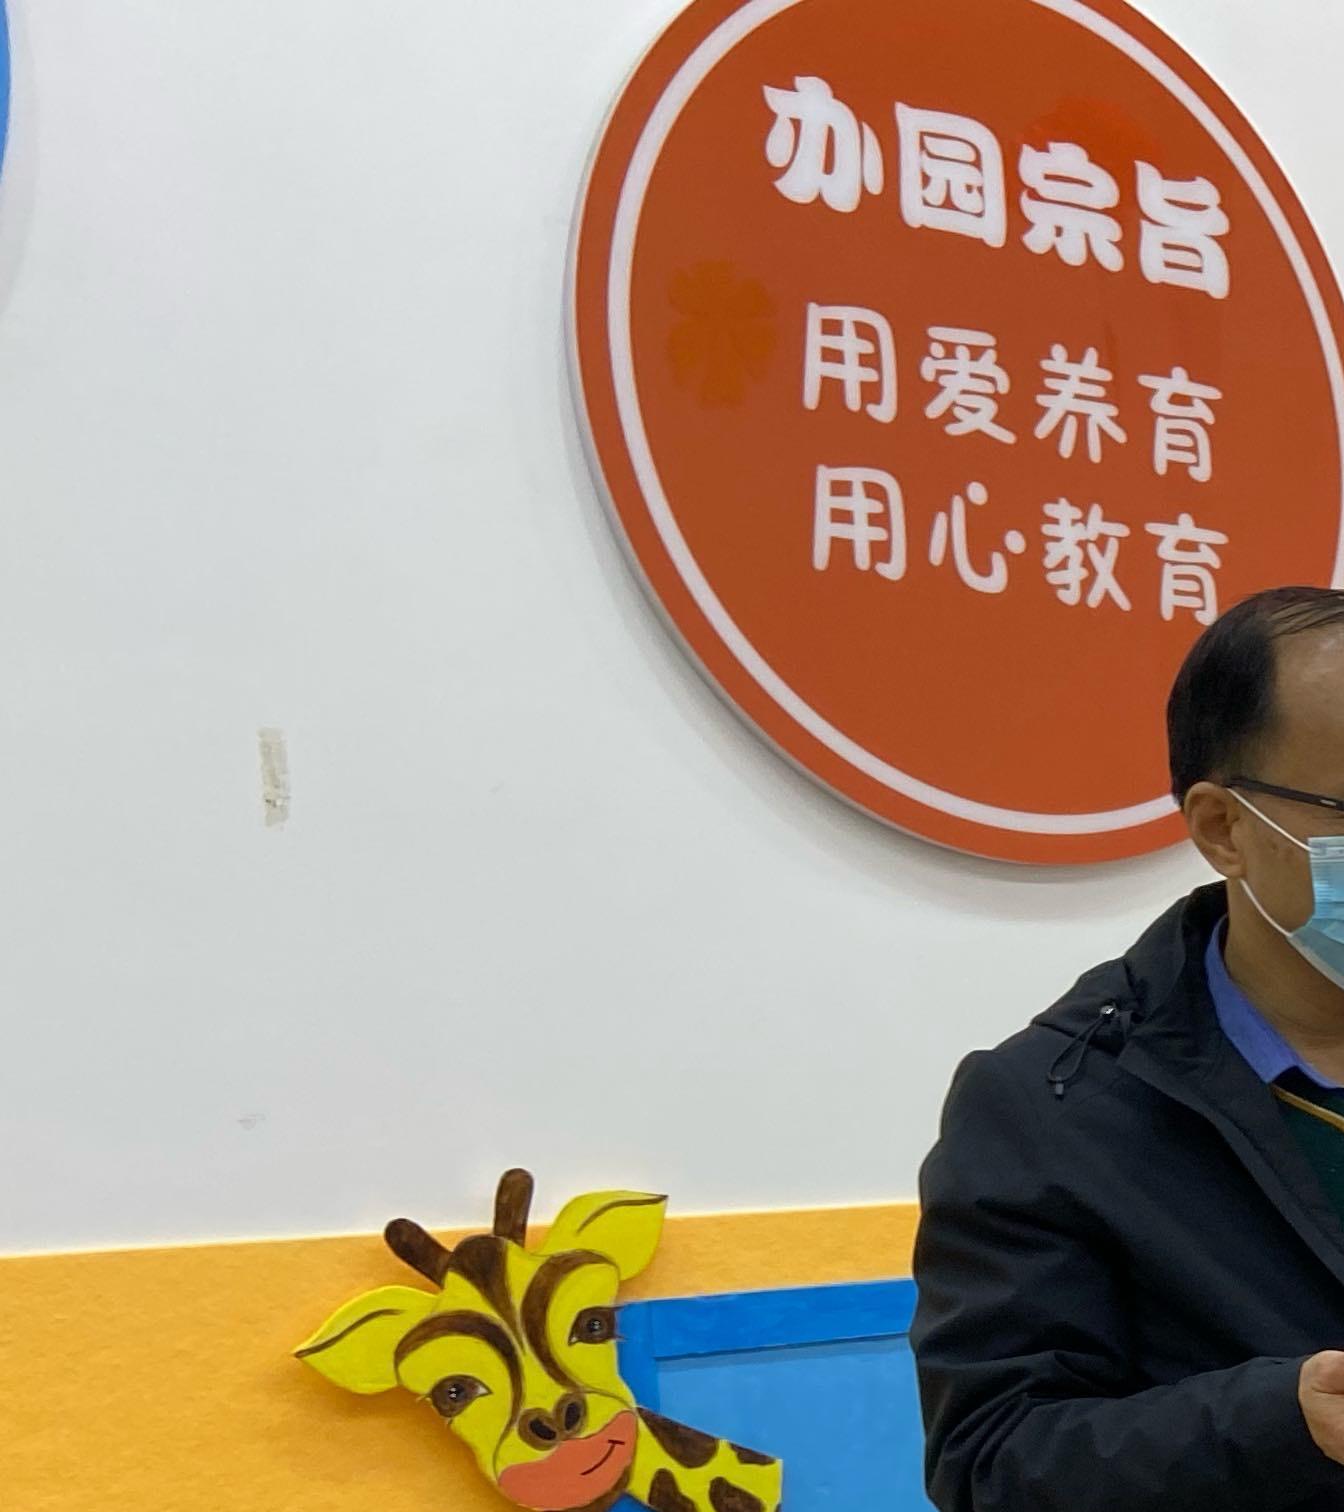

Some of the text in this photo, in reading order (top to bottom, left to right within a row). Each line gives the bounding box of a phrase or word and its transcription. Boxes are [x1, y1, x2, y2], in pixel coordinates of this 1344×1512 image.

[763, 76, 1231, 299] 办园宗旨
[803, 302, 1222, 483] 用爱养育
[813, 464, 1229, 625] 用心教育
